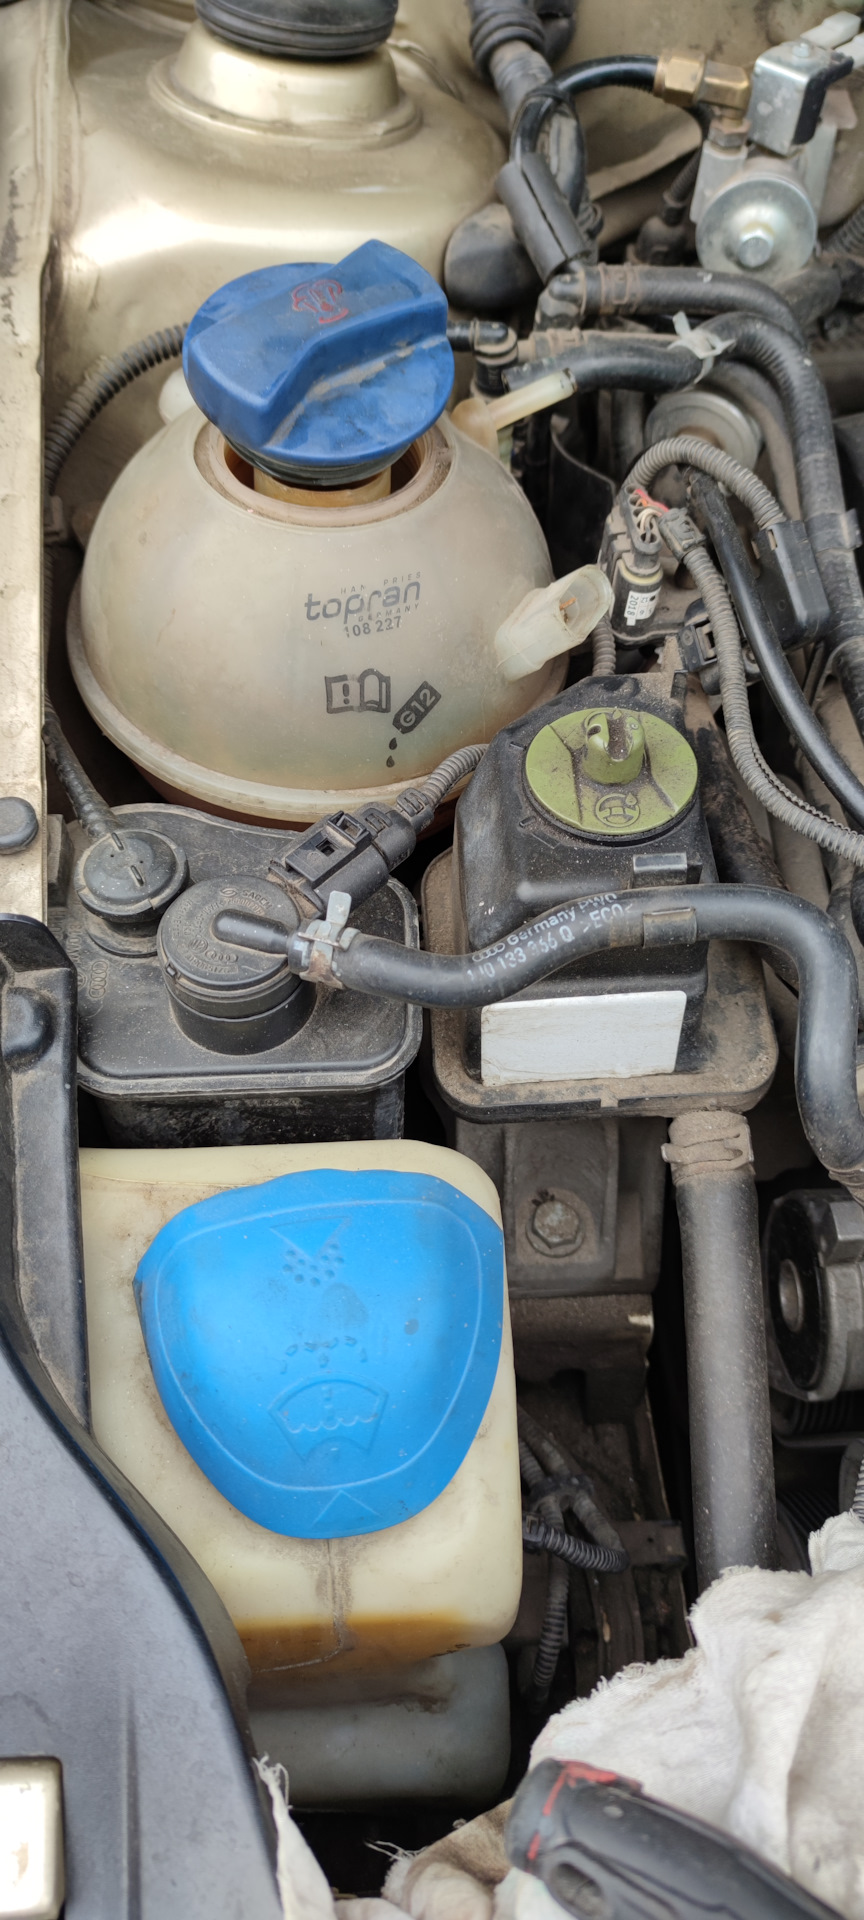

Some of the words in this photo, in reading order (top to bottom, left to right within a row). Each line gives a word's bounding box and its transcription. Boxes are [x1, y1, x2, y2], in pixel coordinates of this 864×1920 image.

[383, 571, 421, 586] PRIES
[304, 581, 421, 625] topran
[626, 595, 640, 616] 2018
[344, 622, 371, 638] 108
[375, 615, 402, 633] 227
[400, 688, 436, 727] G12
[506, 906, 576, 946] Germany
[496, 946, 527, 970] 133
[558, 924, 575, 943] Q
